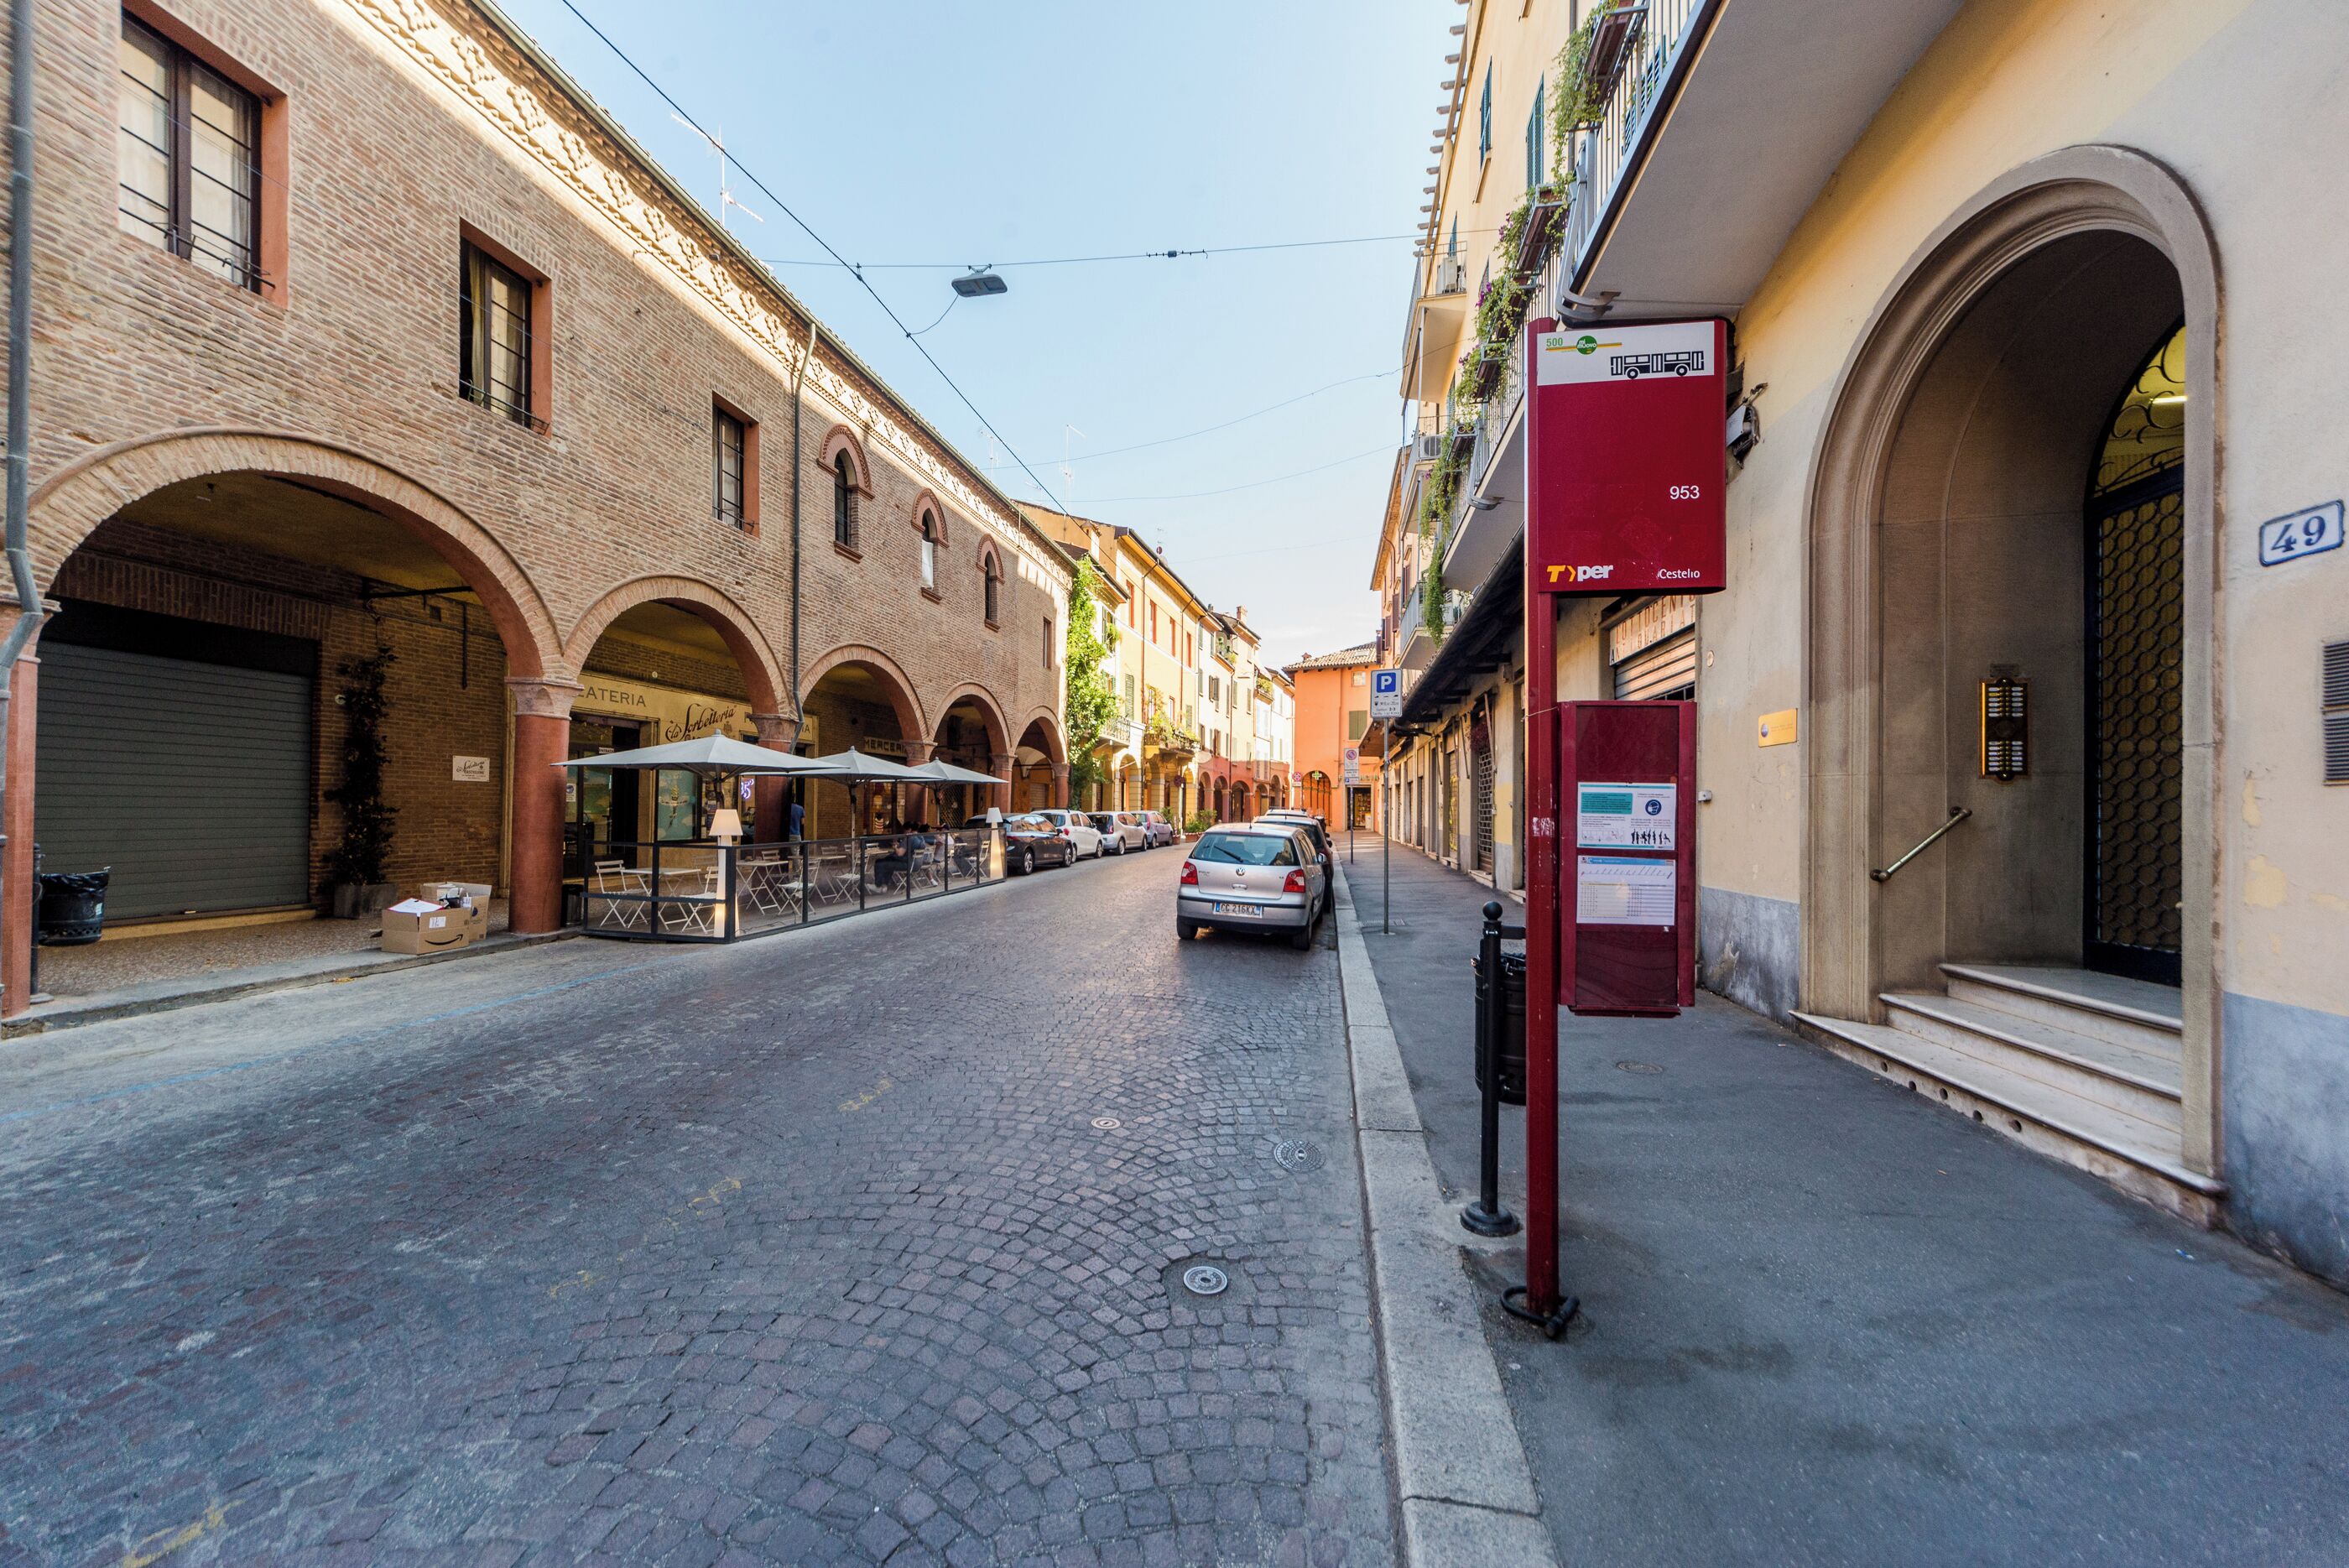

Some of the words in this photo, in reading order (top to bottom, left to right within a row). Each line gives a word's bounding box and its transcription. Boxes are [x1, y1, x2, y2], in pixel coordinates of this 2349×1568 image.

[1546, 337, 1564, 346] 500
[1669, 485, 1700, 500] 953
[2270, 515, 2326, 553] 49
[1381, 675, 1393, 690] P
[865, 737, 907, 754] MERCERI
